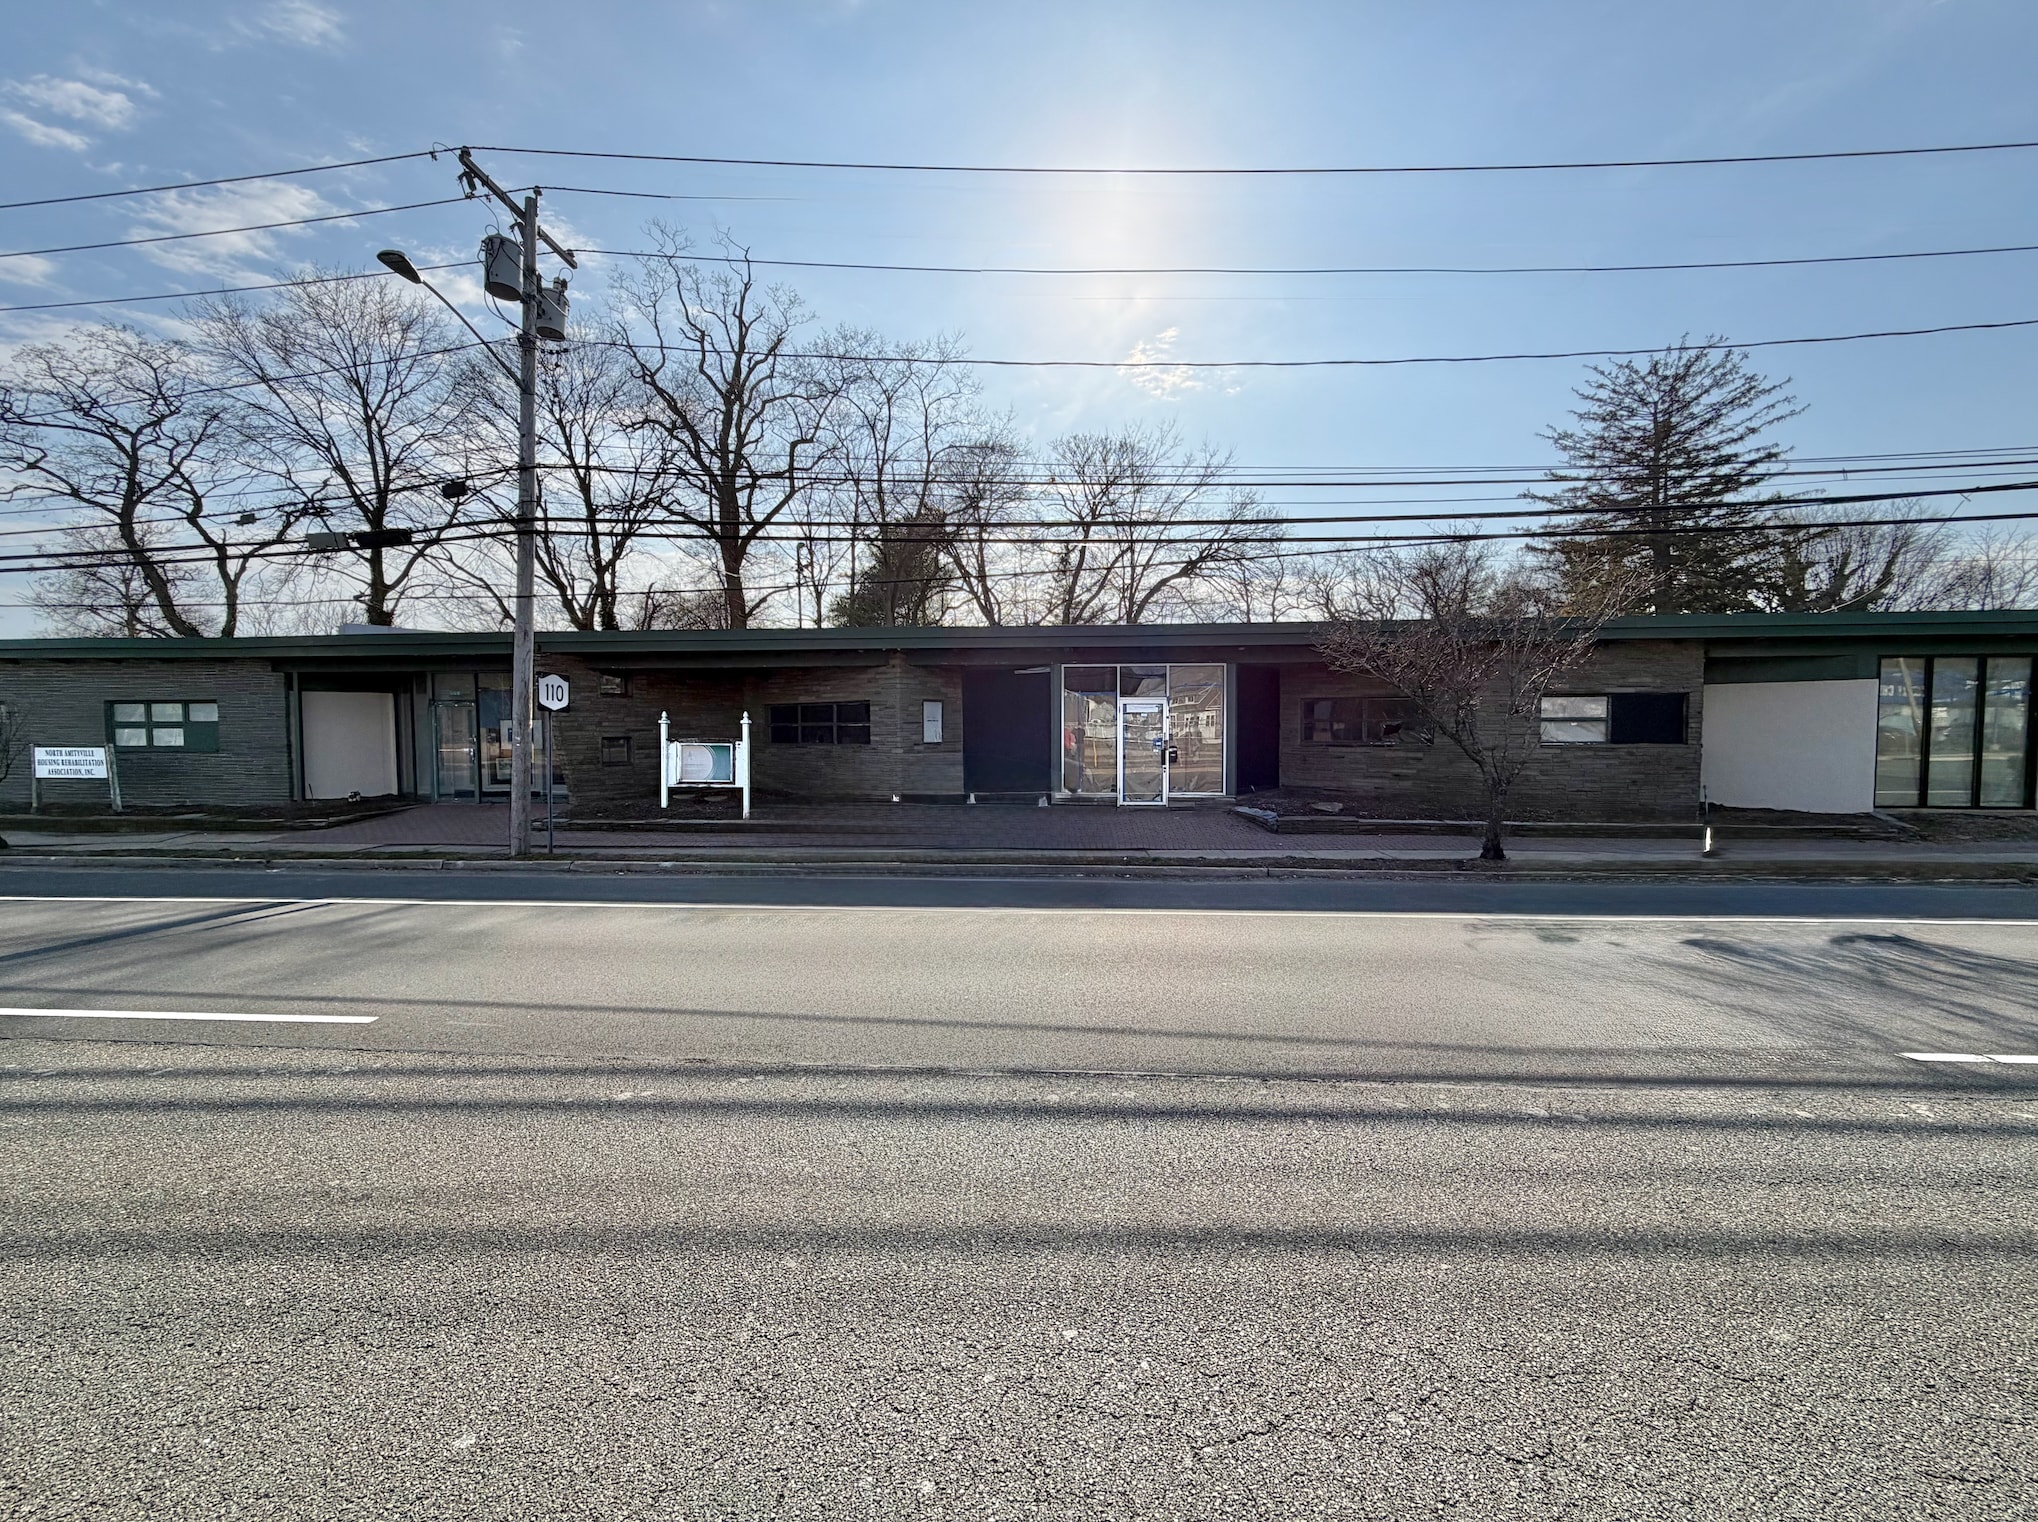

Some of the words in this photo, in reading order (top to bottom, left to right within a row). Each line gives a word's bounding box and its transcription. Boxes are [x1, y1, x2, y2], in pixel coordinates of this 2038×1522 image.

[545, 683, 564, 702] 110
[45, 749, 63, 757] NORTH
[64, 749, 94, 757] AMITYVILLE
